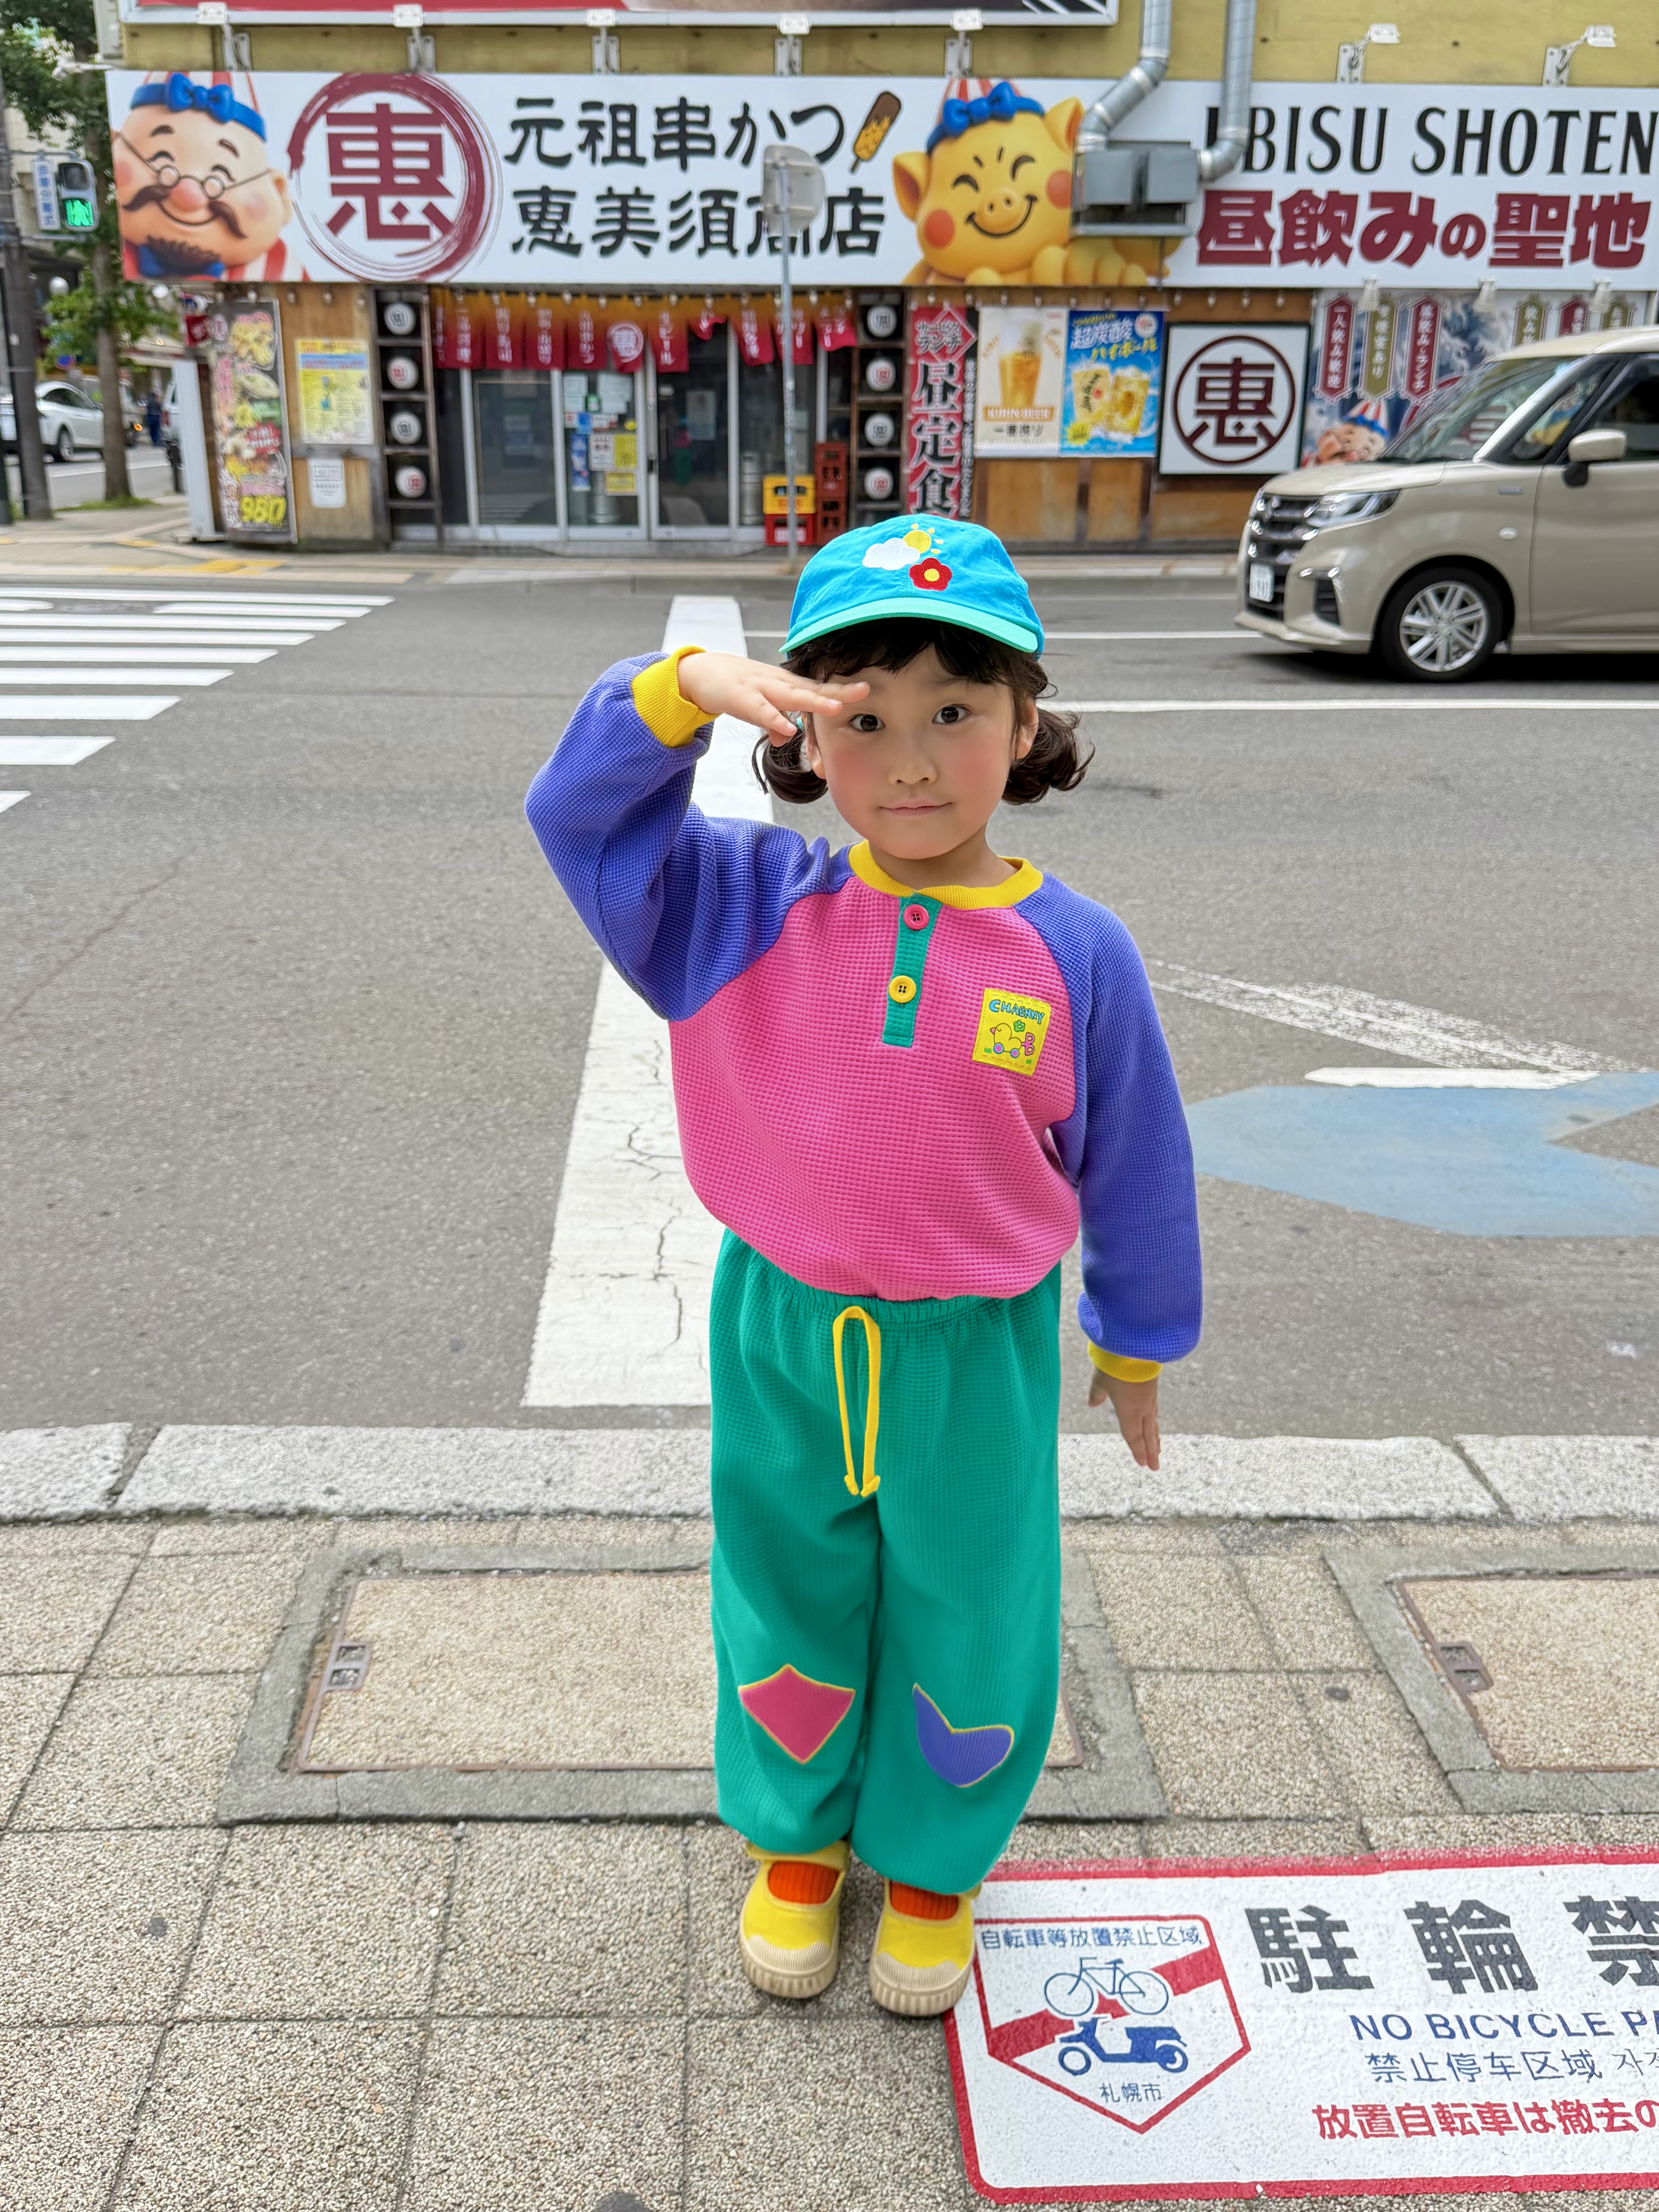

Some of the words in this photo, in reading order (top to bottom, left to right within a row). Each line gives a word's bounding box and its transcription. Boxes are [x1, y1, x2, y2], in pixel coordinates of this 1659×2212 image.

[504, 96, 845, 172] 元祖串かつ
[1412, 107, 1659, 175] SHOTEN
[1198, 189, 1652, 269] 昼飲みの聖地
[1091, 337, 1158, 364] ハイボール
[910, 359, 964, 518] 昼定食
[240, 495, 287, 524] 980
[988, 999, 1045, 1025] CHAENNY
[981, 1925, 1203, 1950] 自転車等放置禁止区域
[1349, 2014, 1413, 2041] NO
[1425, 2012, 1615, 2040] BICYCLE
[1620, 2010, 1659, 2037] P
[1365, 2048, 1603, 2084] 禁止停车区域
[1099, 2081, 1163, 2104] 札幌市
[1311, 2098, 1659, 2140] 放置自転車は撤去の
